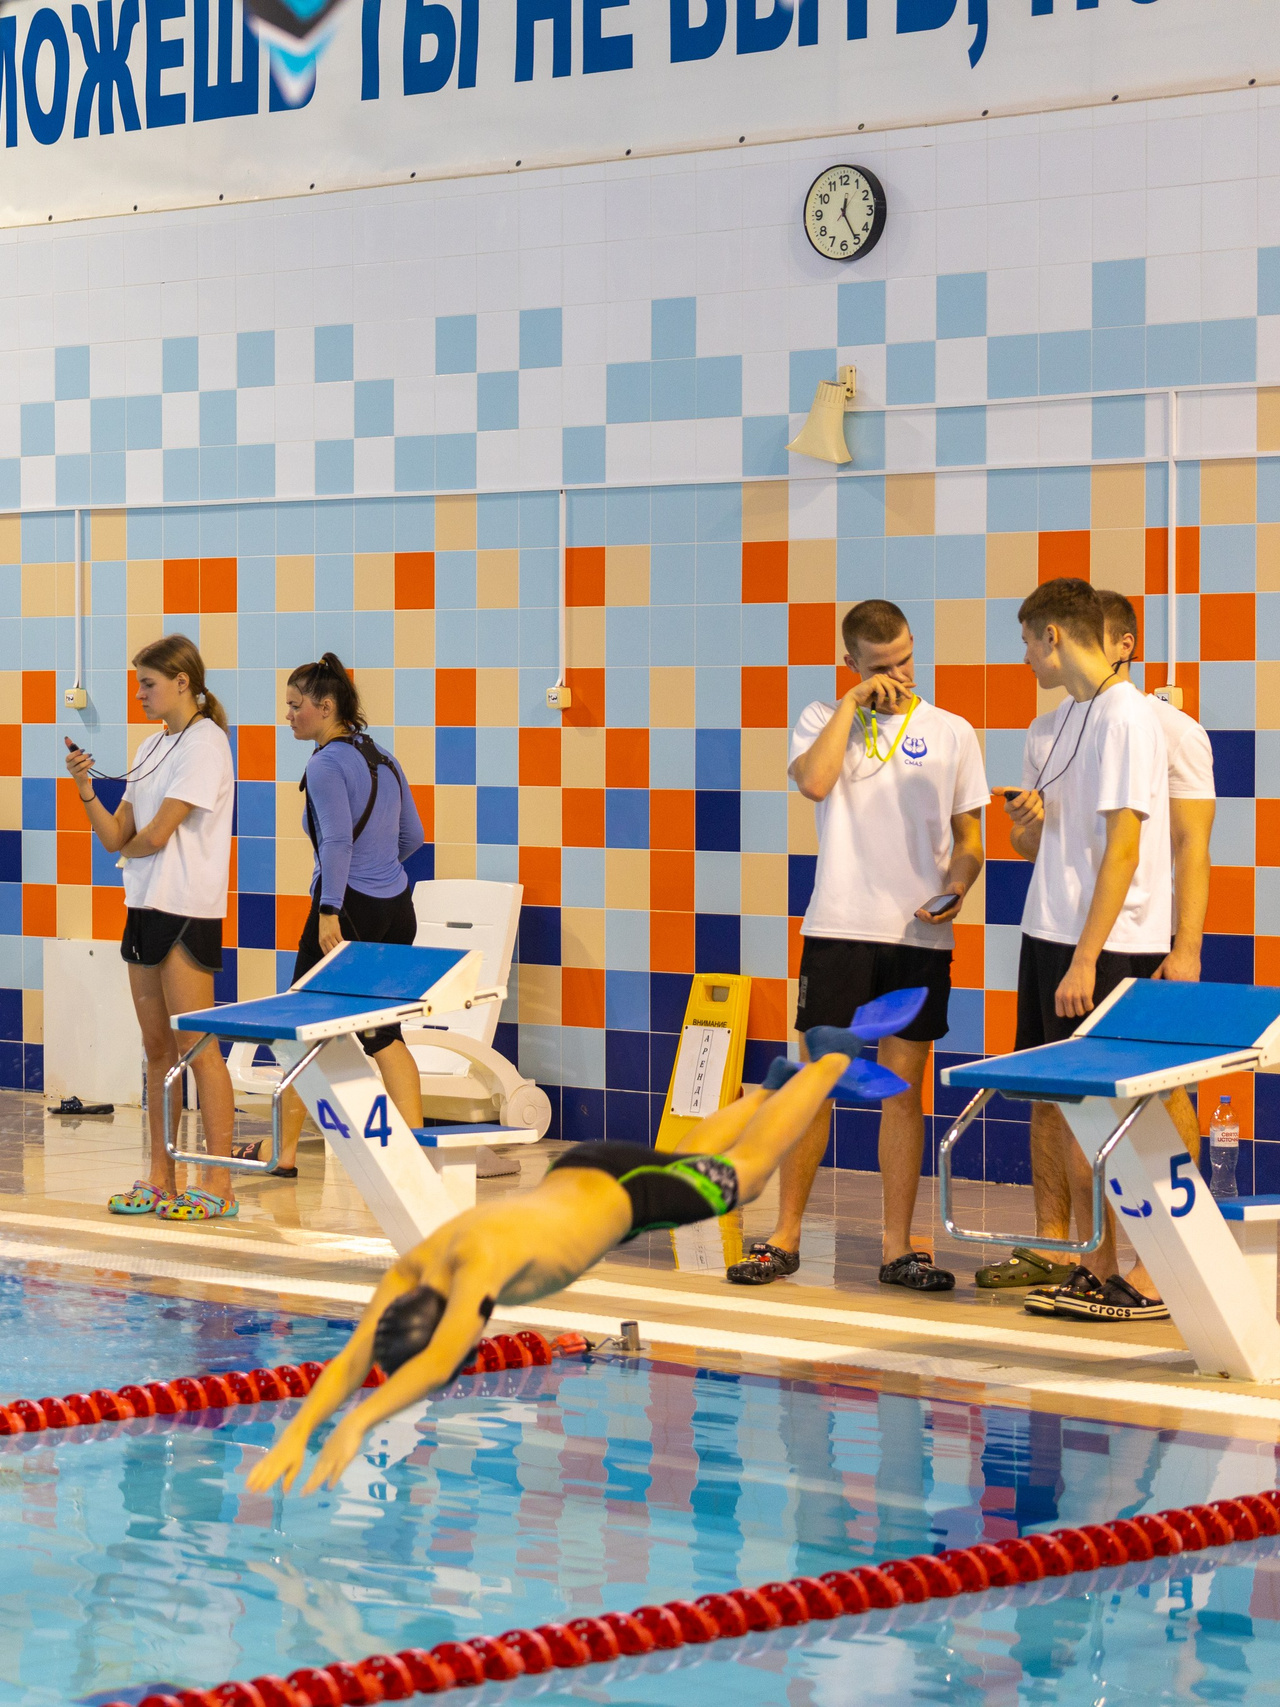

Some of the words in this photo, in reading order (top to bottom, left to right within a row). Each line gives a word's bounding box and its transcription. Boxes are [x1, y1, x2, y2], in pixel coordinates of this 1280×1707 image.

[839, 174, 850, 186] 12
[855, 179, 859, 189] 1
[828, 181, 837, 192] 11
[819, 193, 830, 205] 10
[862, 190, 869, 201] 2
[815, 209, 823, 221] 9
[866, 205, 874, 216] 3
[819, 226, 827, 237] 8
[862, 222, 869, 232] 4
[829, 236, 836, 247] 7
[853, 234, 861, 245] 5
[840, 240, 848, 251] 6
[904, 759, 923, 767] CMAS
[692, 1019, 728, 1028] ВНИМАНИЕ
[692, 1034, 710, 1107] АРЕНДА
[316, 1098, 351, 1139] 4
[363, 1094, 392, 1147] 4
[1170, 1151, 1196, 1218] 5
[1089, 1304, 1131, 1317] crocs
